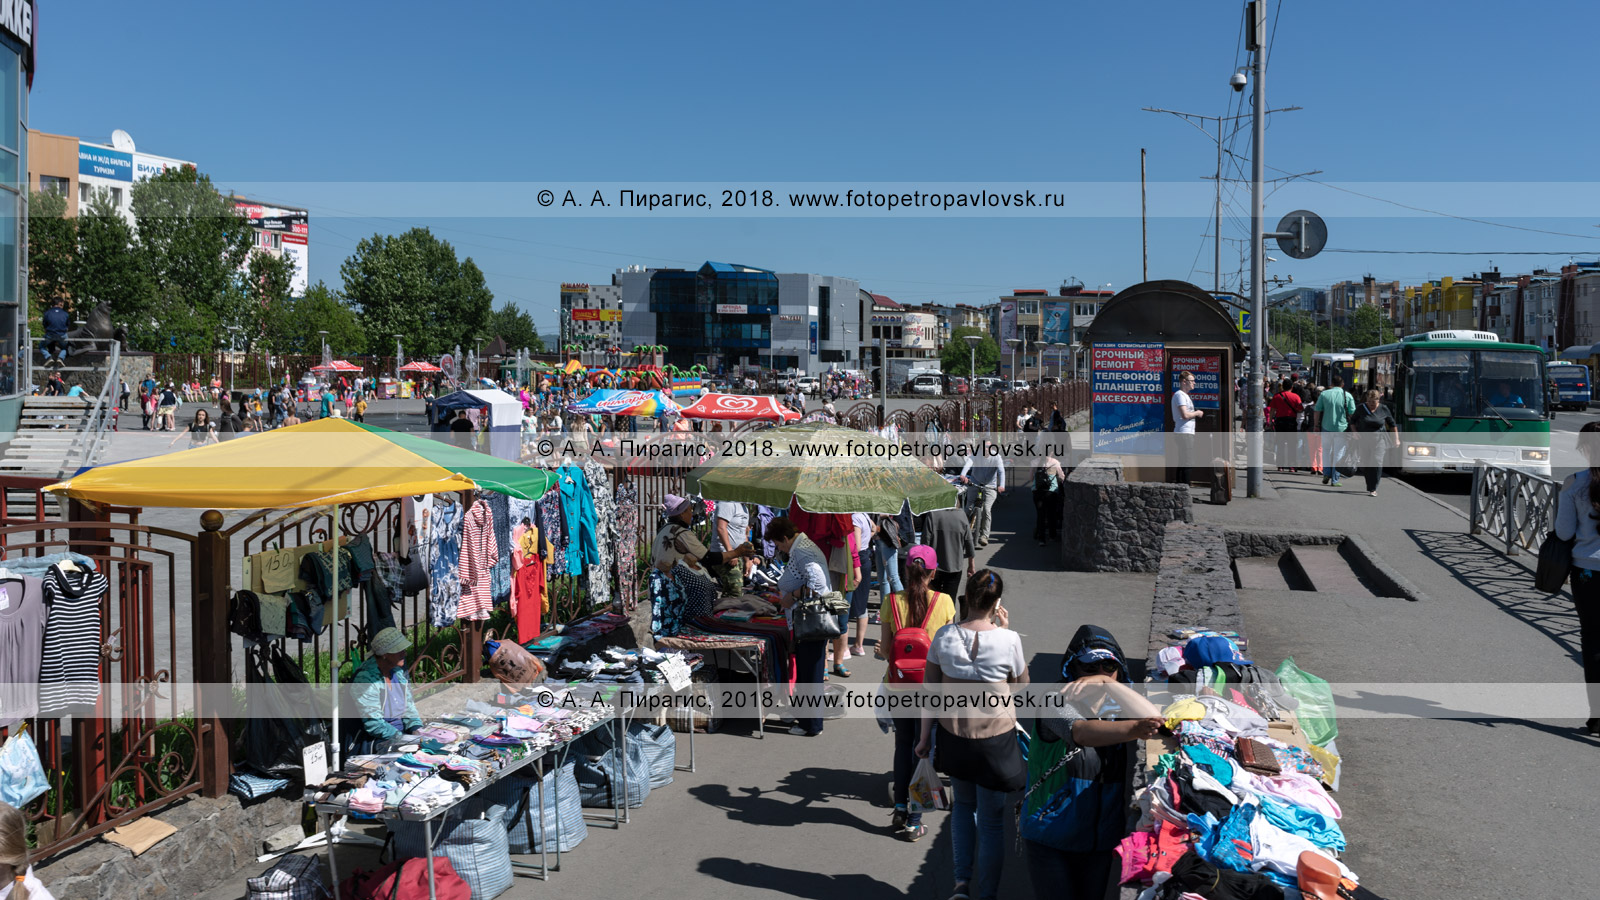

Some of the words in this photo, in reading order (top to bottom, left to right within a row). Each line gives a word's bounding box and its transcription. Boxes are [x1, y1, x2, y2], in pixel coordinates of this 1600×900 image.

[110, 157, 131, 168] БИЛЕТЫ
[93, 165, 115, 175] ТУРИЗМ
[1094, 350, 1145, 359] СРОЧНЫЙ
[1095, 360, 1135, 369] РЕМОНТ
[1095, 372, 1161, 381] ТЕЛЕФОНОВ
[1095, 382, 1163, 392] ПЛАНШЕТОВ
[597, 392, 653, 407] инмарко
[1094, 394, 1162, 403] АКСЕССУАРЫ
[1099, 428, 1112, 436] Все
